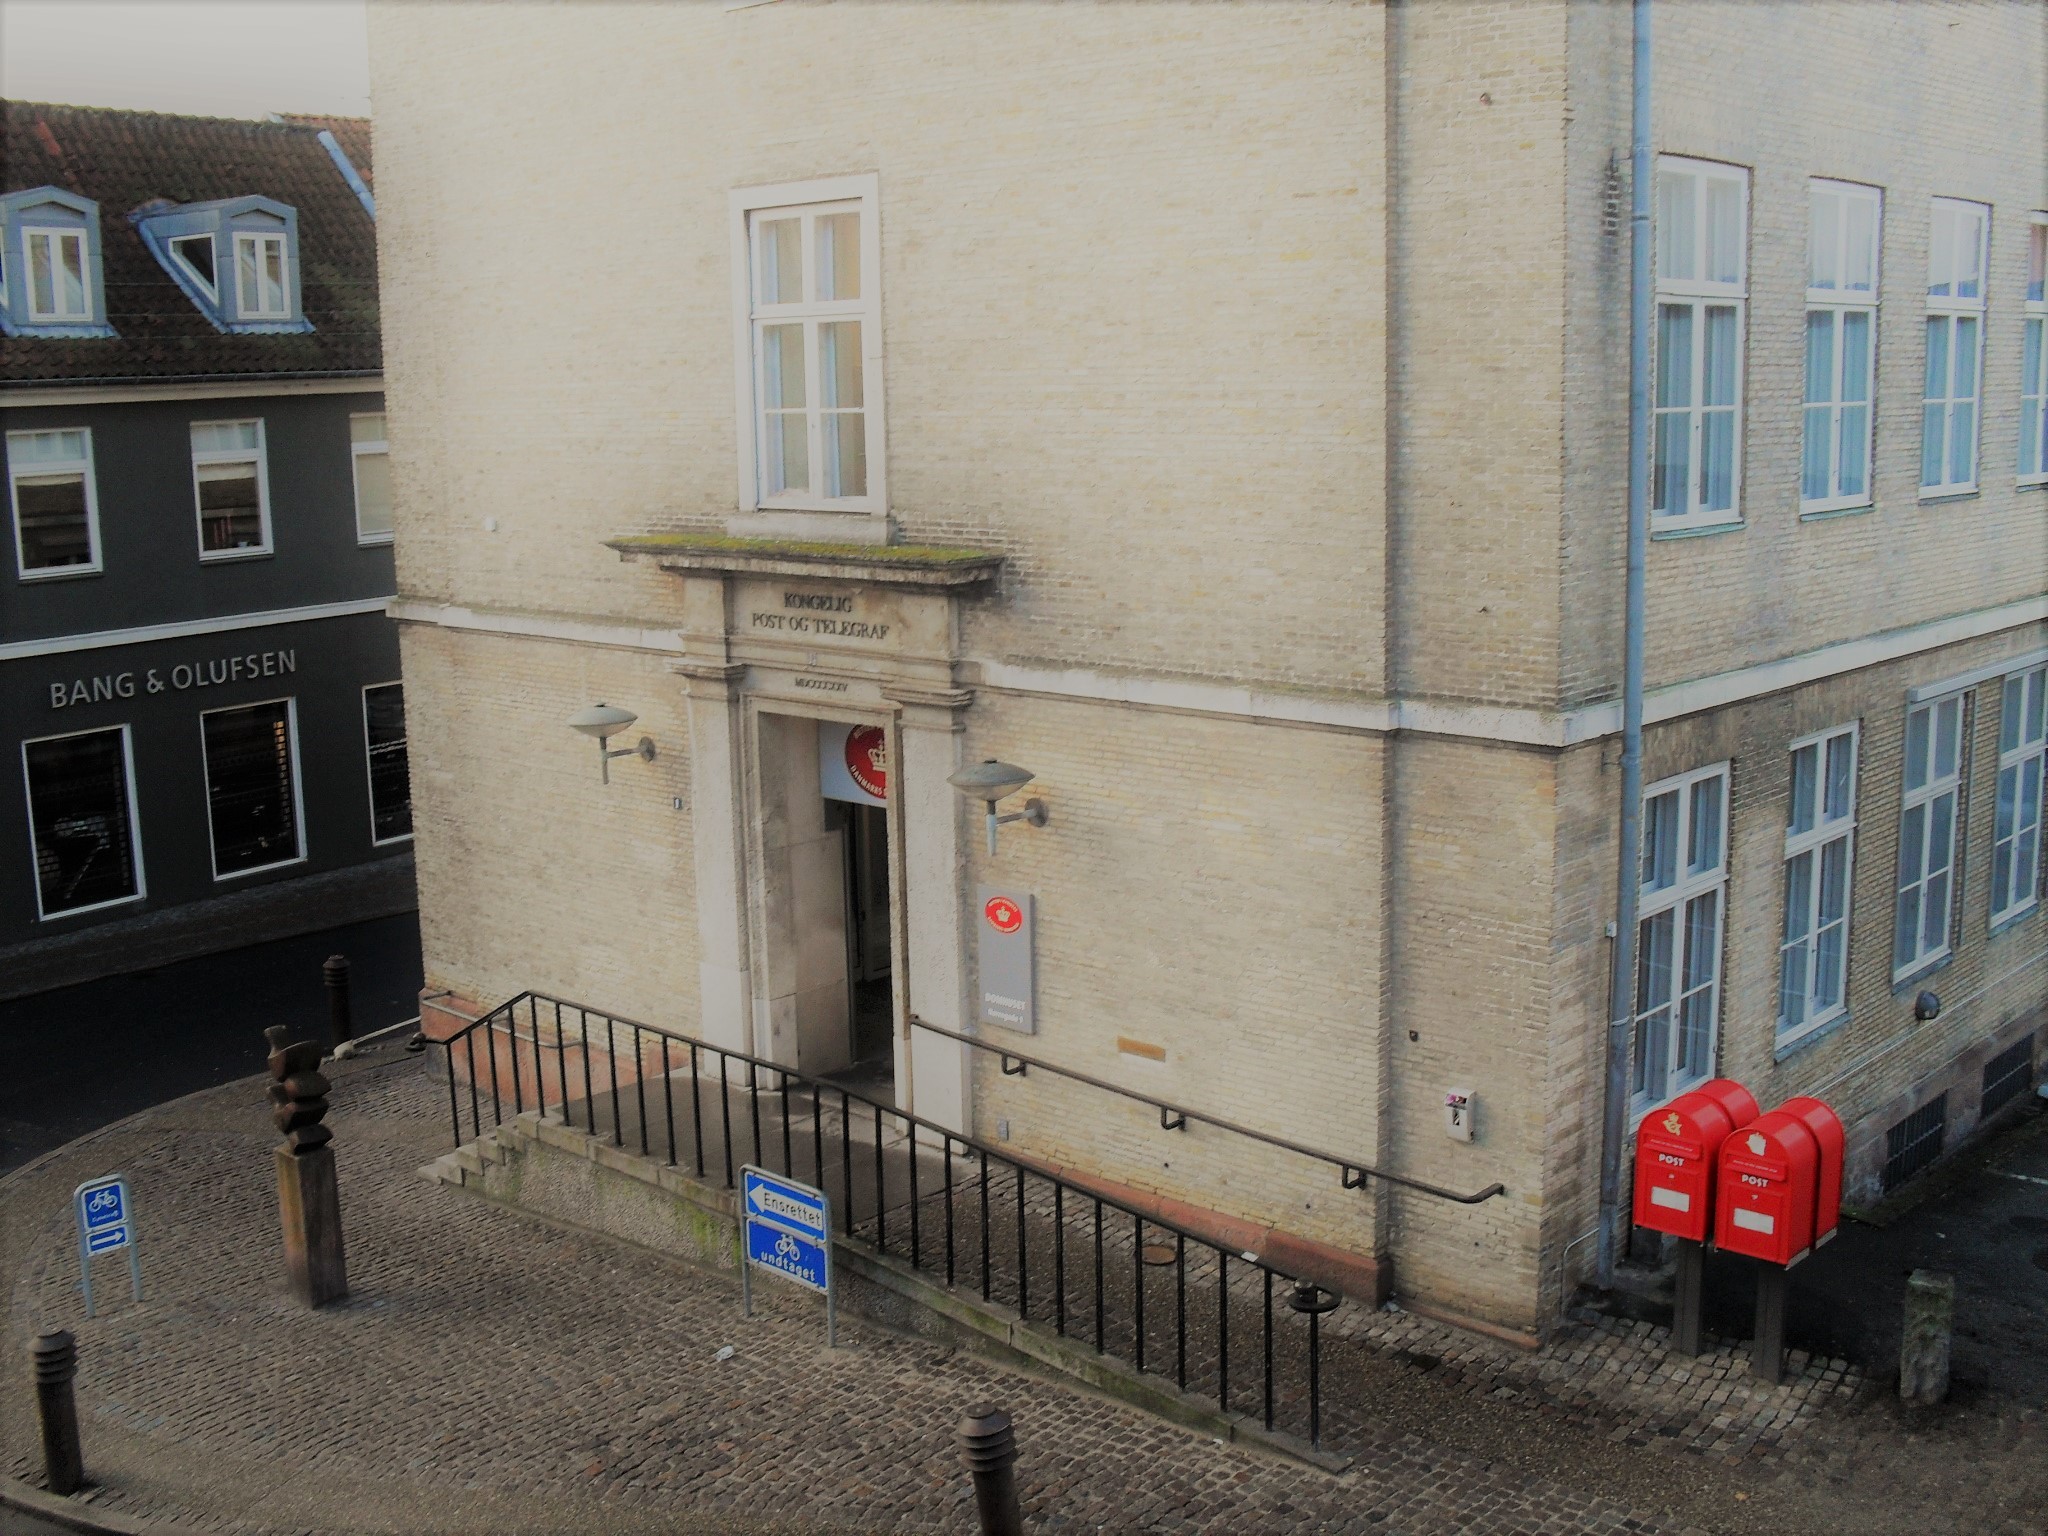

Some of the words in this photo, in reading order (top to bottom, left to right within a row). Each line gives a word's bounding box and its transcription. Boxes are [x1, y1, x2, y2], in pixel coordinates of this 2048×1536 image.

[784, 592, 853, 613] KONGELIG
[752, 612, 785, 630] POST
[789, 615, 810, 632] OG
[814, 618, 890, 640] TELEGRAF
[50, 672, 136, 709] BANG
[146, 669, 165, 694] &
[171, 649, 297, 690] OLUFSEN
[1658, 1153, 1685, 1167] POST
[1741, 1174, 1769, 1188] POST
[763, 1191, 821, 1227] Ensrettet
[760, 1250, 816, 1282] undtaget
